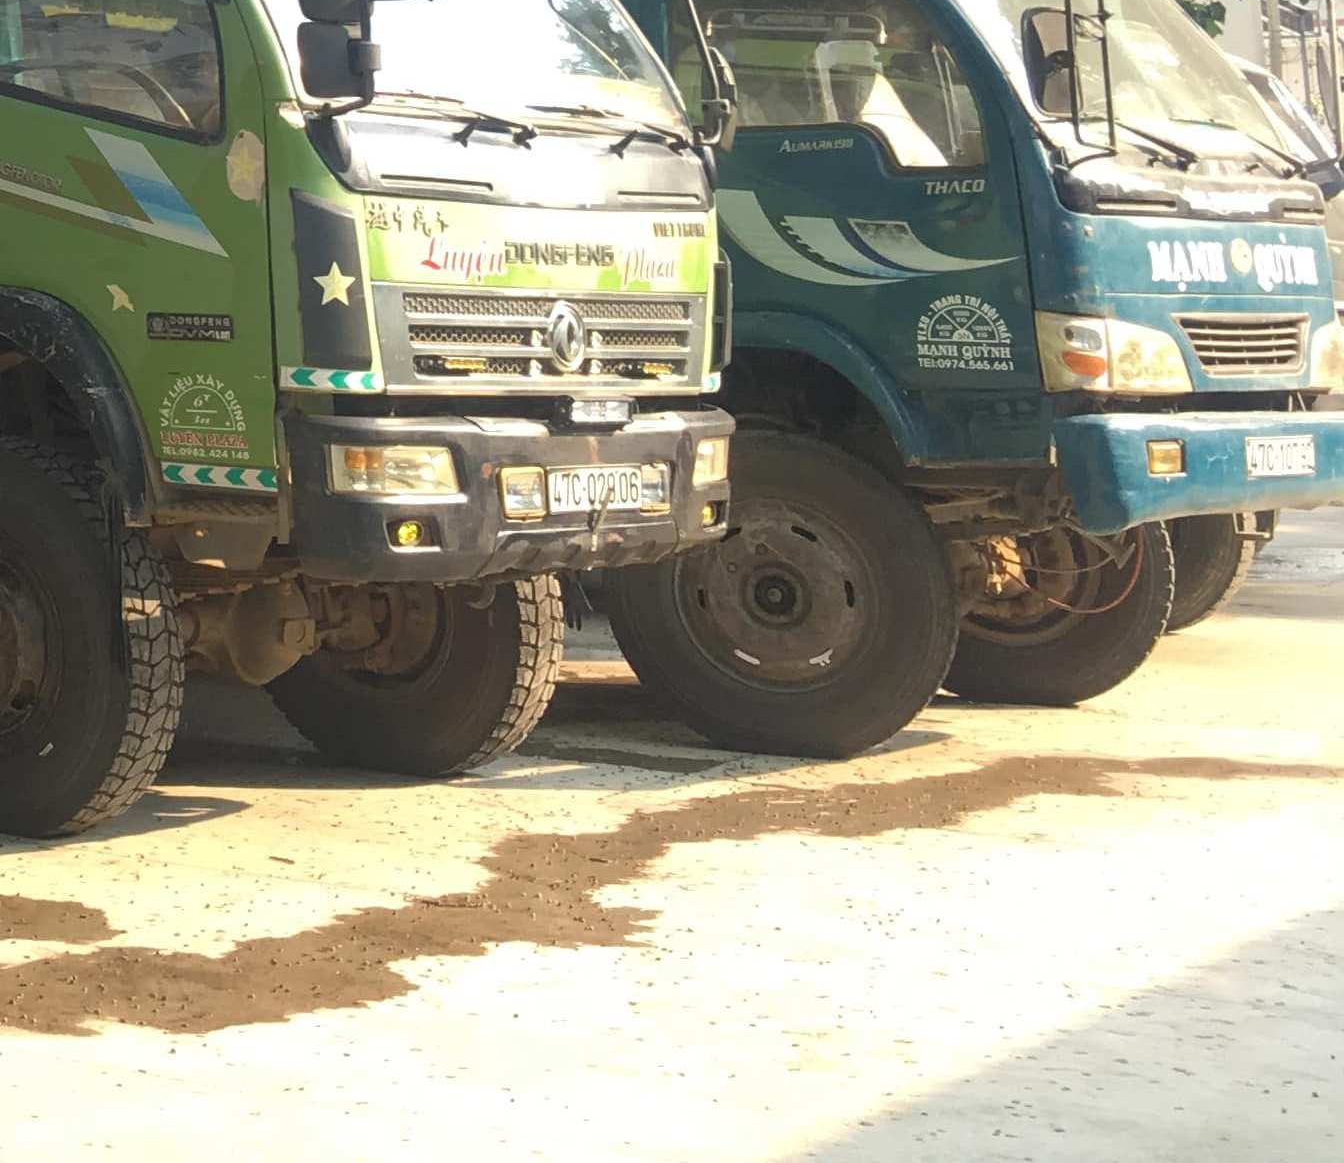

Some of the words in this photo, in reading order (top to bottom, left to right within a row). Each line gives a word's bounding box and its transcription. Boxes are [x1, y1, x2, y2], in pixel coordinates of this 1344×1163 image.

[925, 179, 985, 195] THACO
[504, 241, 615, 267] DONGFENG
[1147, 241, 1228, 292] MẠNH
